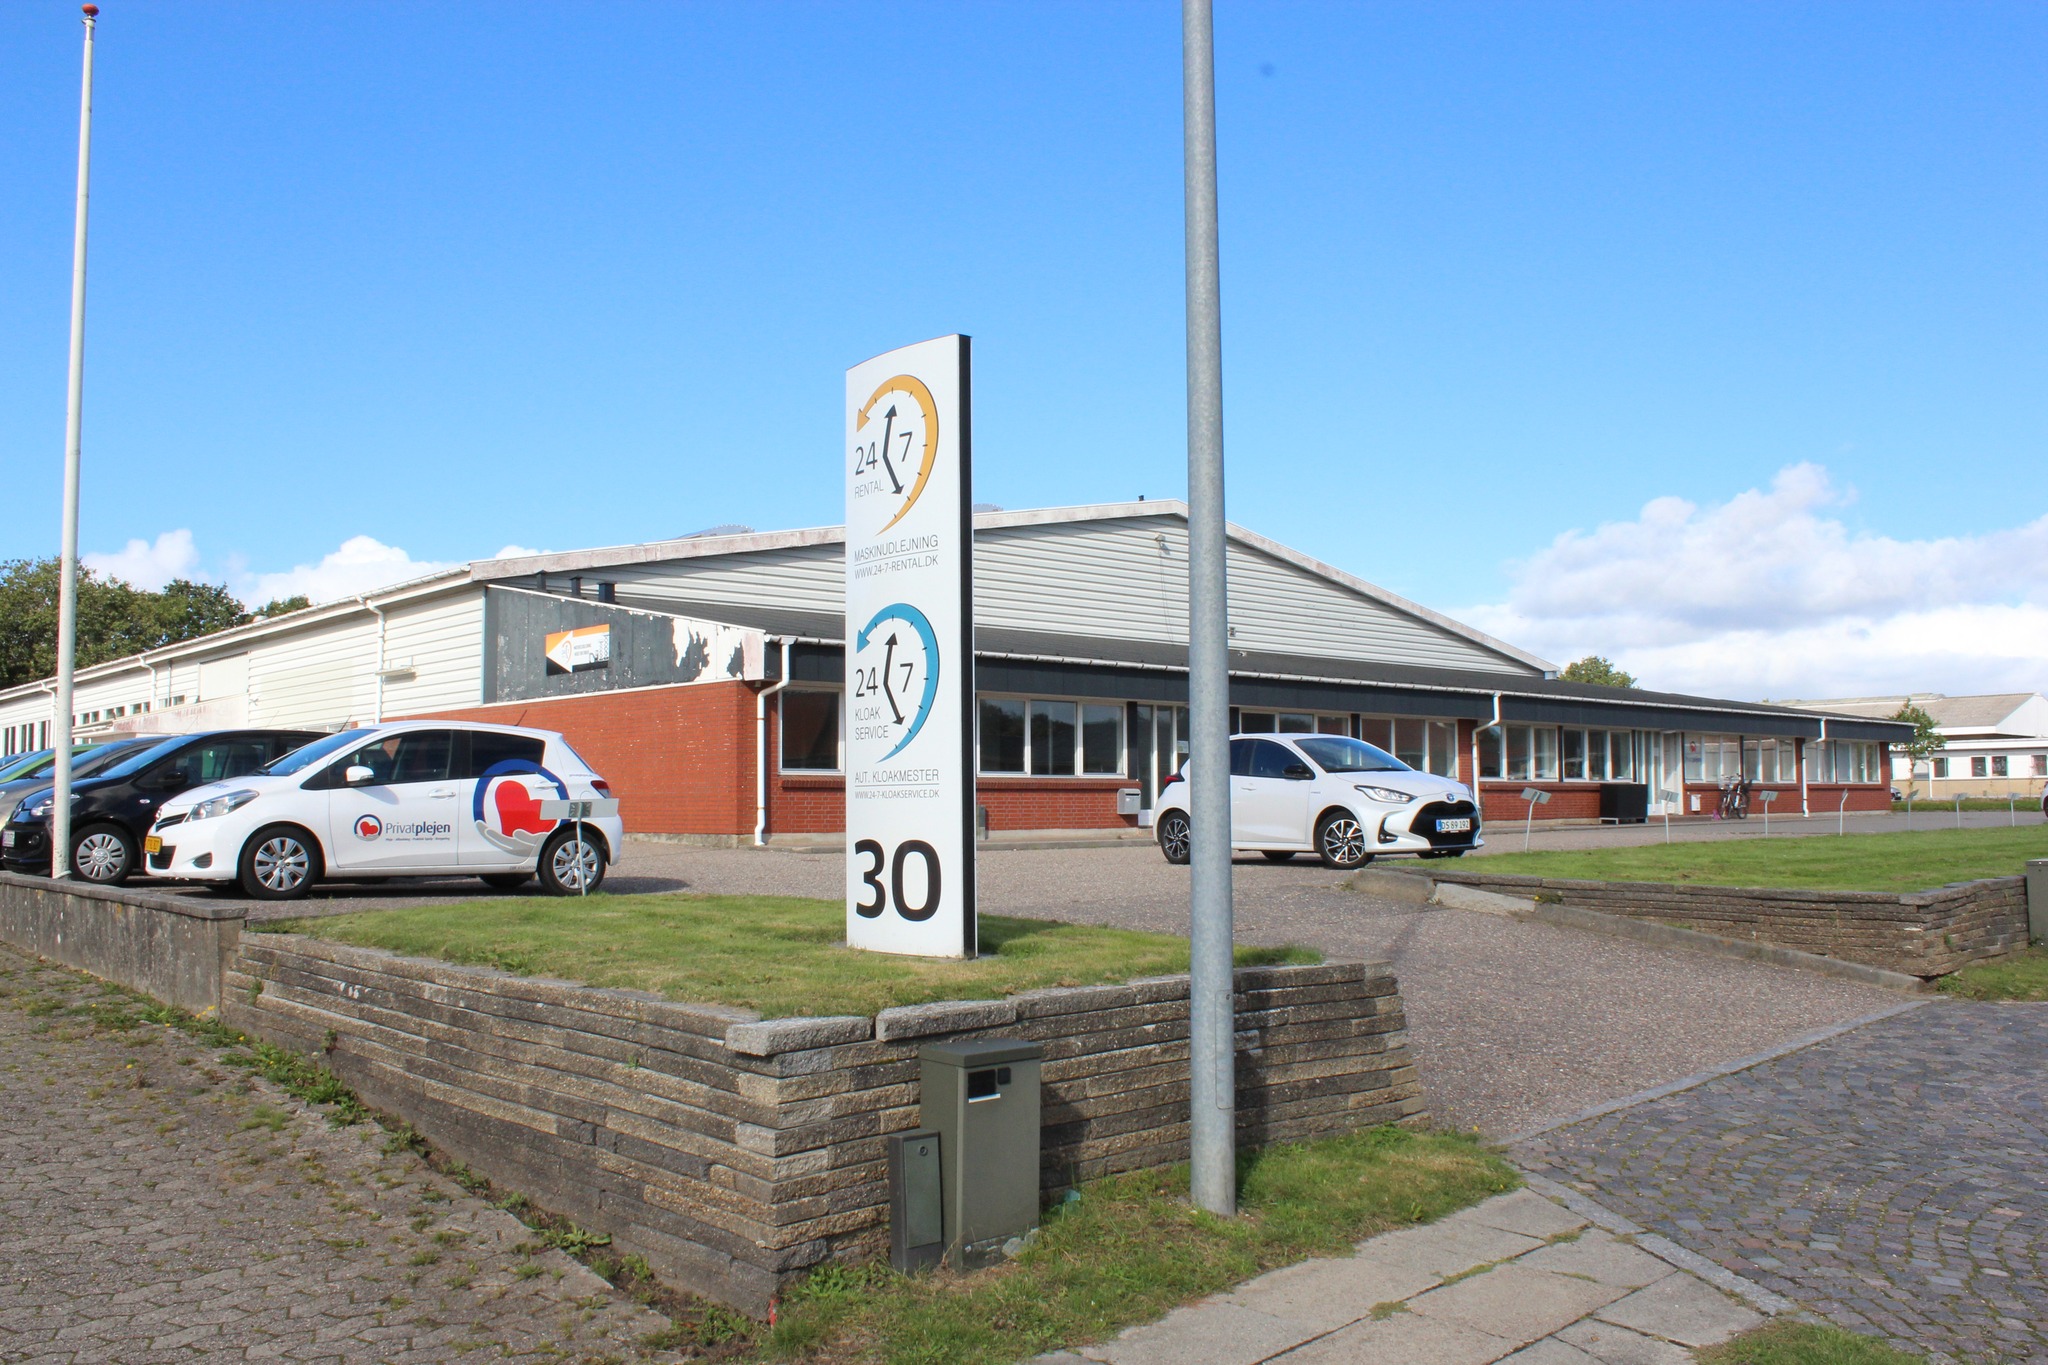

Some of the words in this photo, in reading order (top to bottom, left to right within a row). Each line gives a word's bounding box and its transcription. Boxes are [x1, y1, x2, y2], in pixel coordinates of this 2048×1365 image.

[855, 441, 878, 475] 24
[899, 431, 913, 462] 7
[854, 479, 884, 499] RENTAL
[854, 534, 939, 562] MASKINUDLEJNING
[854, 554, 939, 580] WWW.24-7-RENTAL.DK
[855, 666, 879, 698] 24
[899, 662, 914, 693] 7
[855, 707, 881, 722] KLOAK
[855, 725, 889, 741] SERVICE
[855, 771, 870, 783] AUT.
[872, 768, 939, 783] KLOAKMESTER
[855, 789, 940, 800] WWW.24-7-KLOAKSERVICE.DK
[385, 821, 451, 836] Privatplejen
[854, 838, 942, 922] 30
